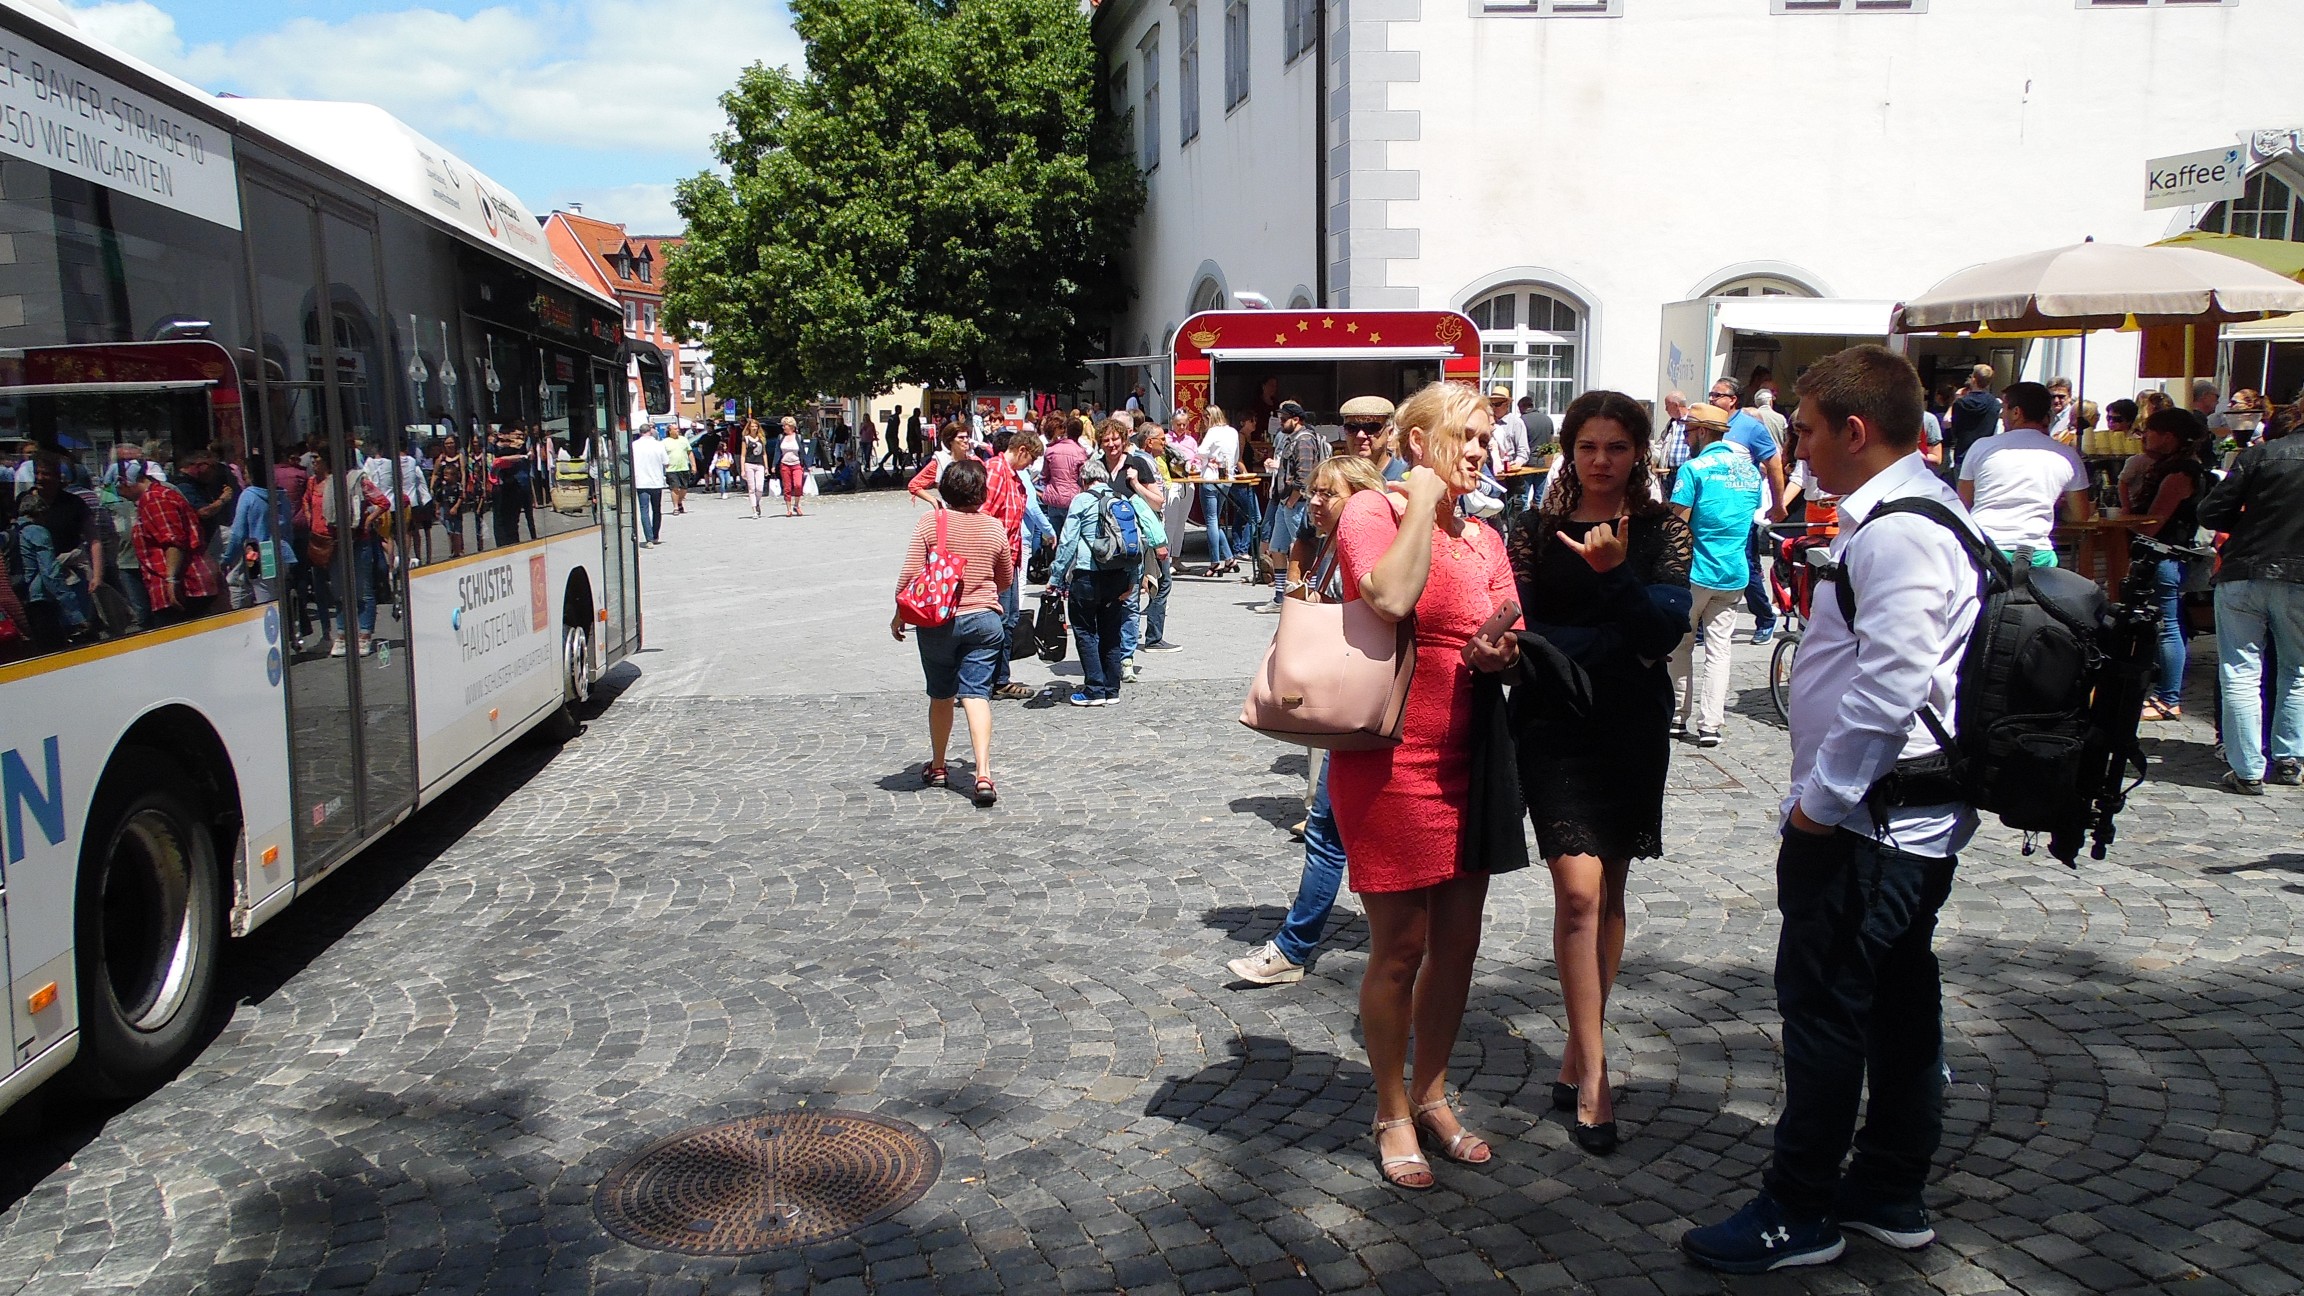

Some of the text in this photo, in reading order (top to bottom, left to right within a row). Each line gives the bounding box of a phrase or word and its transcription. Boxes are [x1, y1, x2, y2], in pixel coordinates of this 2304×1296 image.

[38, 116, 173, 197] WEINGARTEN
[186, 131, 204, 165] 10
[2149, 164, 2225, 191] Kaffee
[458, 564, 514, 613] SCHUSTER
[461, 604, 528, 663] HAUSTECHNIK
[1, 734, 66, 866] N
